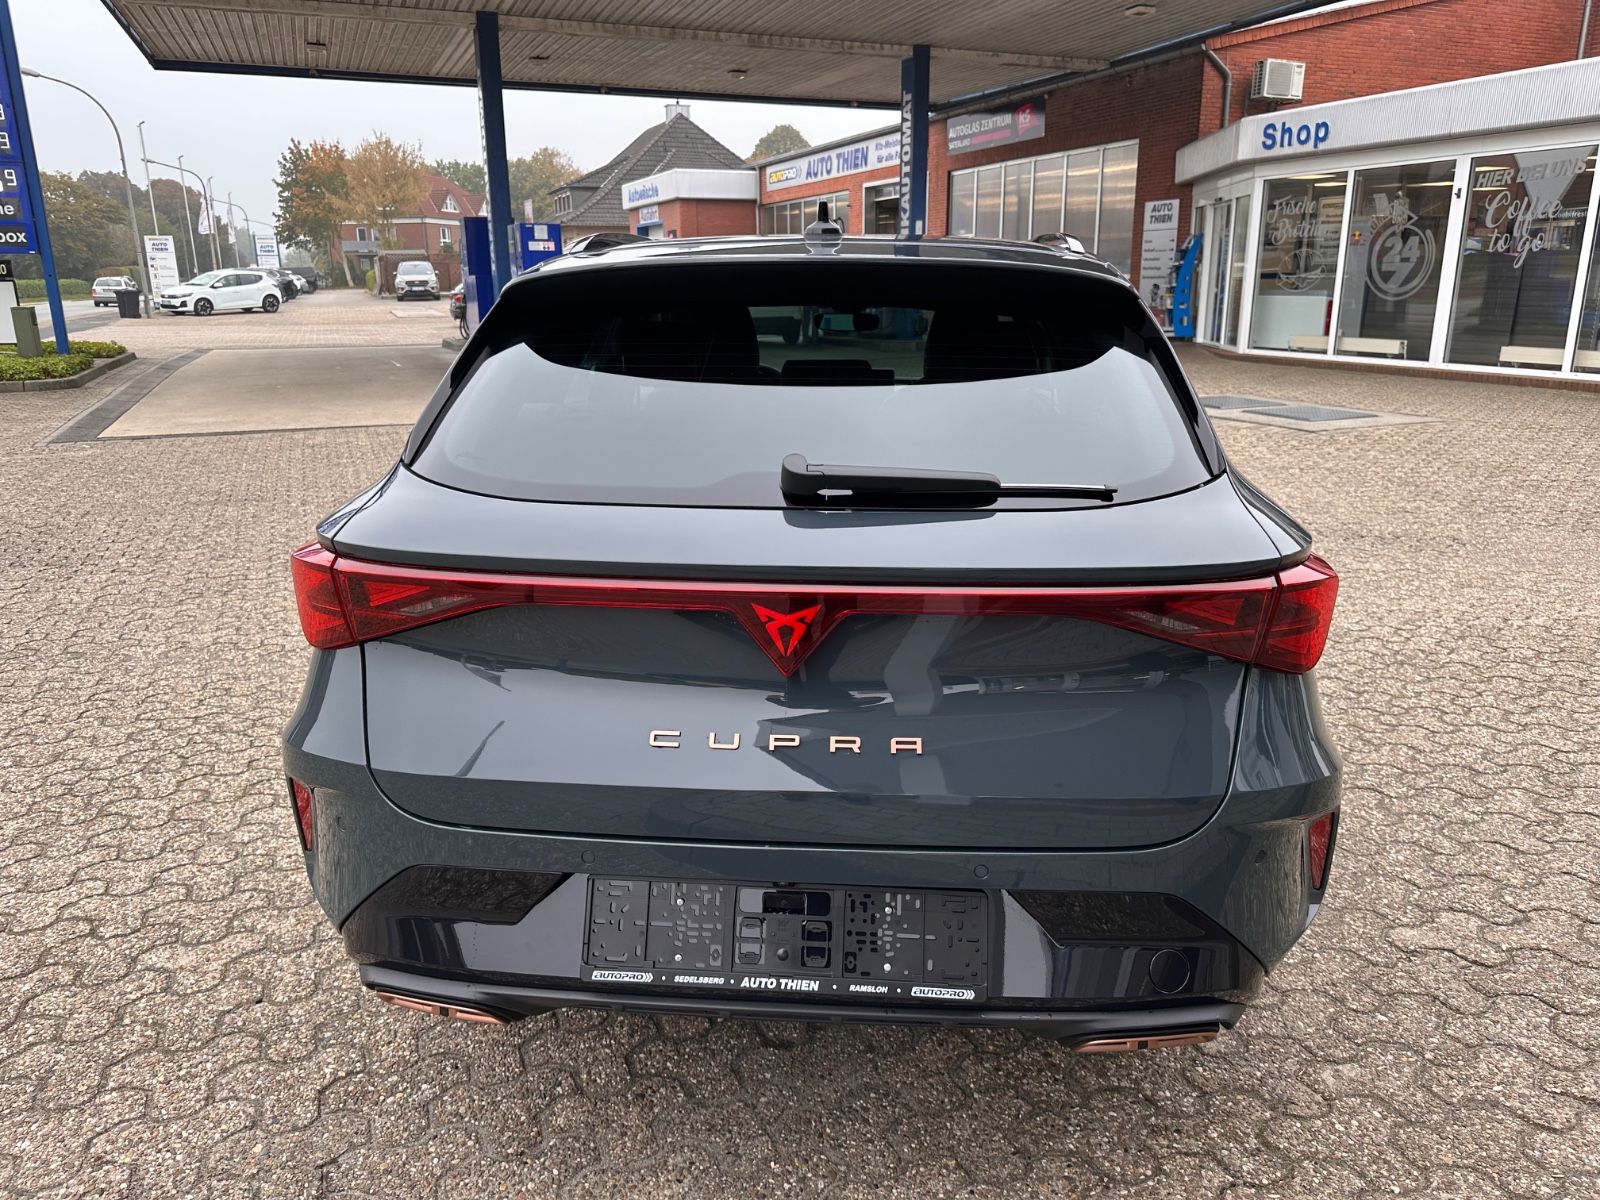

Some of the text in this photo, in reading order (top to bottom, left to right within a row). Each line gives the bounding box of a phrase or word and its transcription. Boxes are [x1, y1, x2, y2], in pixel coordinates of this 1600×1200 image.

[948, 114, 1012, 138] AUTOGLAS ZENTRUM
[1262, 121, 1329, 150] Shop
[805, 154, 832, 180] AUTO
[835, 146, 869, 173] THIEN
[1476, 169, 1514, 188] HIER
[1549, 159, 1587, 177] UNS
[1149, 214, 1174, 225] THIEN
[1151, 203, 1173, 213] AUTO
[1266, 194, 1317, 224] Frische
[1485, 190, 1563, 237] Coffee
[1381, 235, 1420, 264] 24
[1486, 228, 1546, 269] to go
[649, 729, 923, 756] CUPRA
[673, 975, 725, 985] SEDELSBERG
[740, 976, 777, 989] AUTO
[779, 978, 820, 991] THIEN
[849, 984, 889, 994] RAMSLOH
